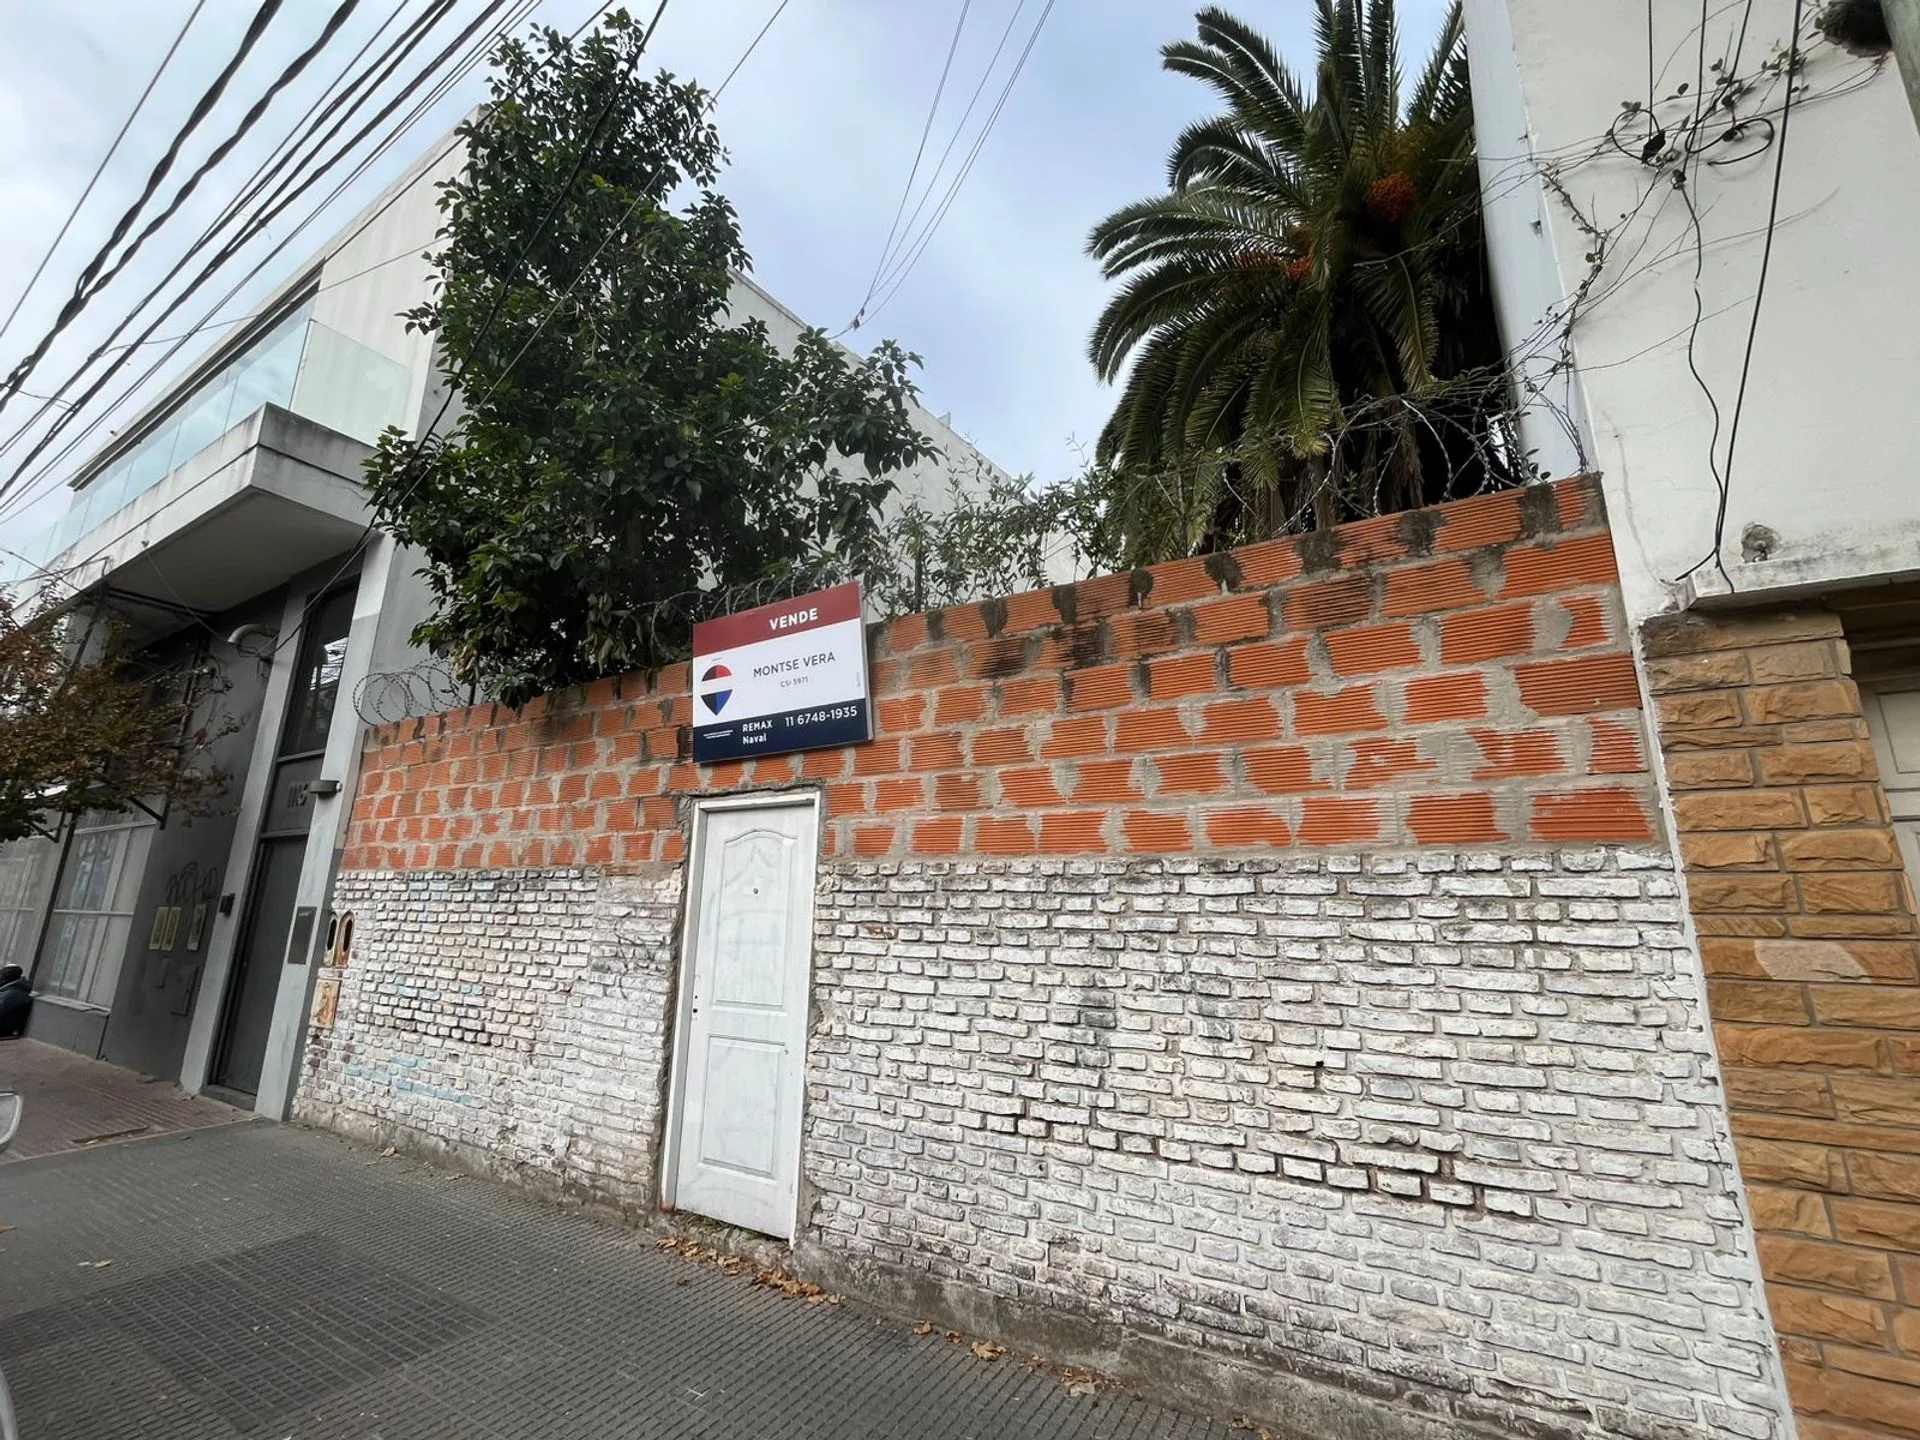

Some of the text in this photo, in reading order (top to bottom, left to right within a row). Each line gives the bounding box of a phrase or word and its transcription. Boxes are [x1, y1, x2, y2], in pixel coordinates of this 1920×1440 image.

[769, 608, 818, 630] VENDE
[753, 651, 836, 677] MONTSE VERA
[742, 720, 773, 733] REMAX
[785, 706, 857, 727] 11 6748-1935
[742, 733, 767, 745] Naval
